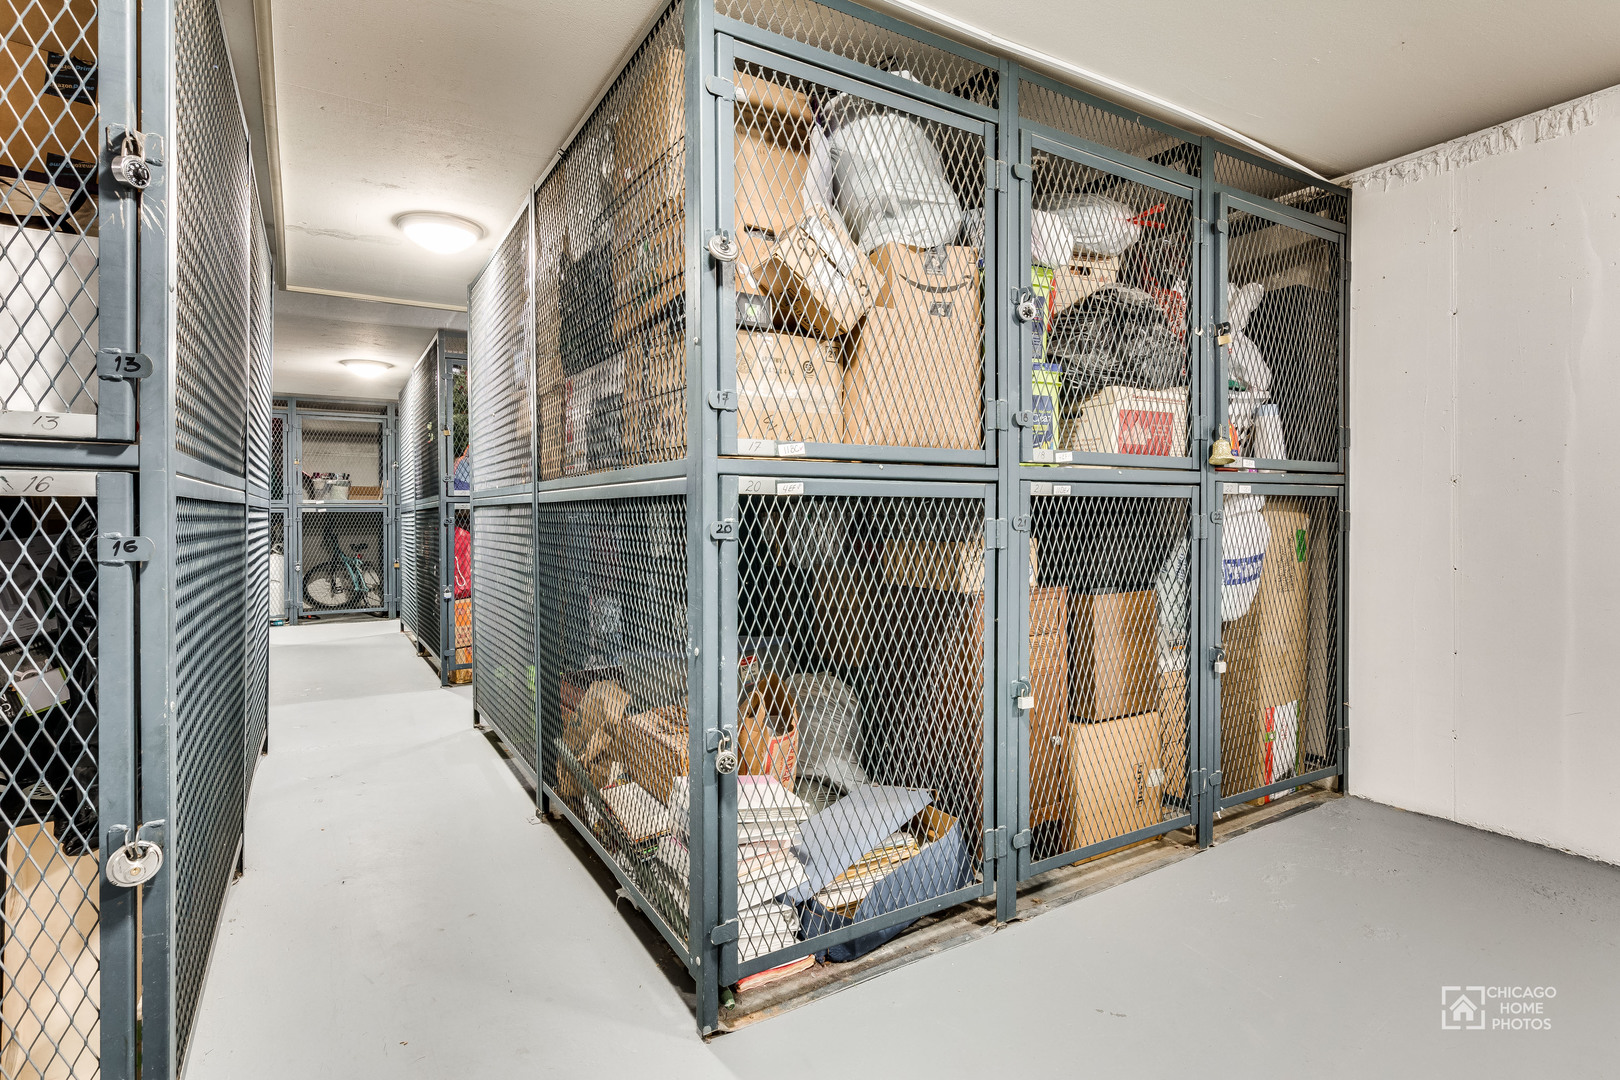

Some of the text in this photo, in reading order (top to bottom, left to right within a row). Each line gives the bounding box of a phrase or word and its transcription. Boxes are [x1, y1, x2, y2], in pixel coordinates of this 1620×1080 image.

[114, 355, 141, 372] 13
[717, 392, 729, 406] 17
[33, 415, 60, 431] 13
[748, 441, 762, 452] 17
[22, 475, 54, 493] 16
[745, 480, 762, 493] 20
[716, 524, 732, 534] 20
[1017, 517, 1027, 528] 21
[112, 539, 138, 557] 16
